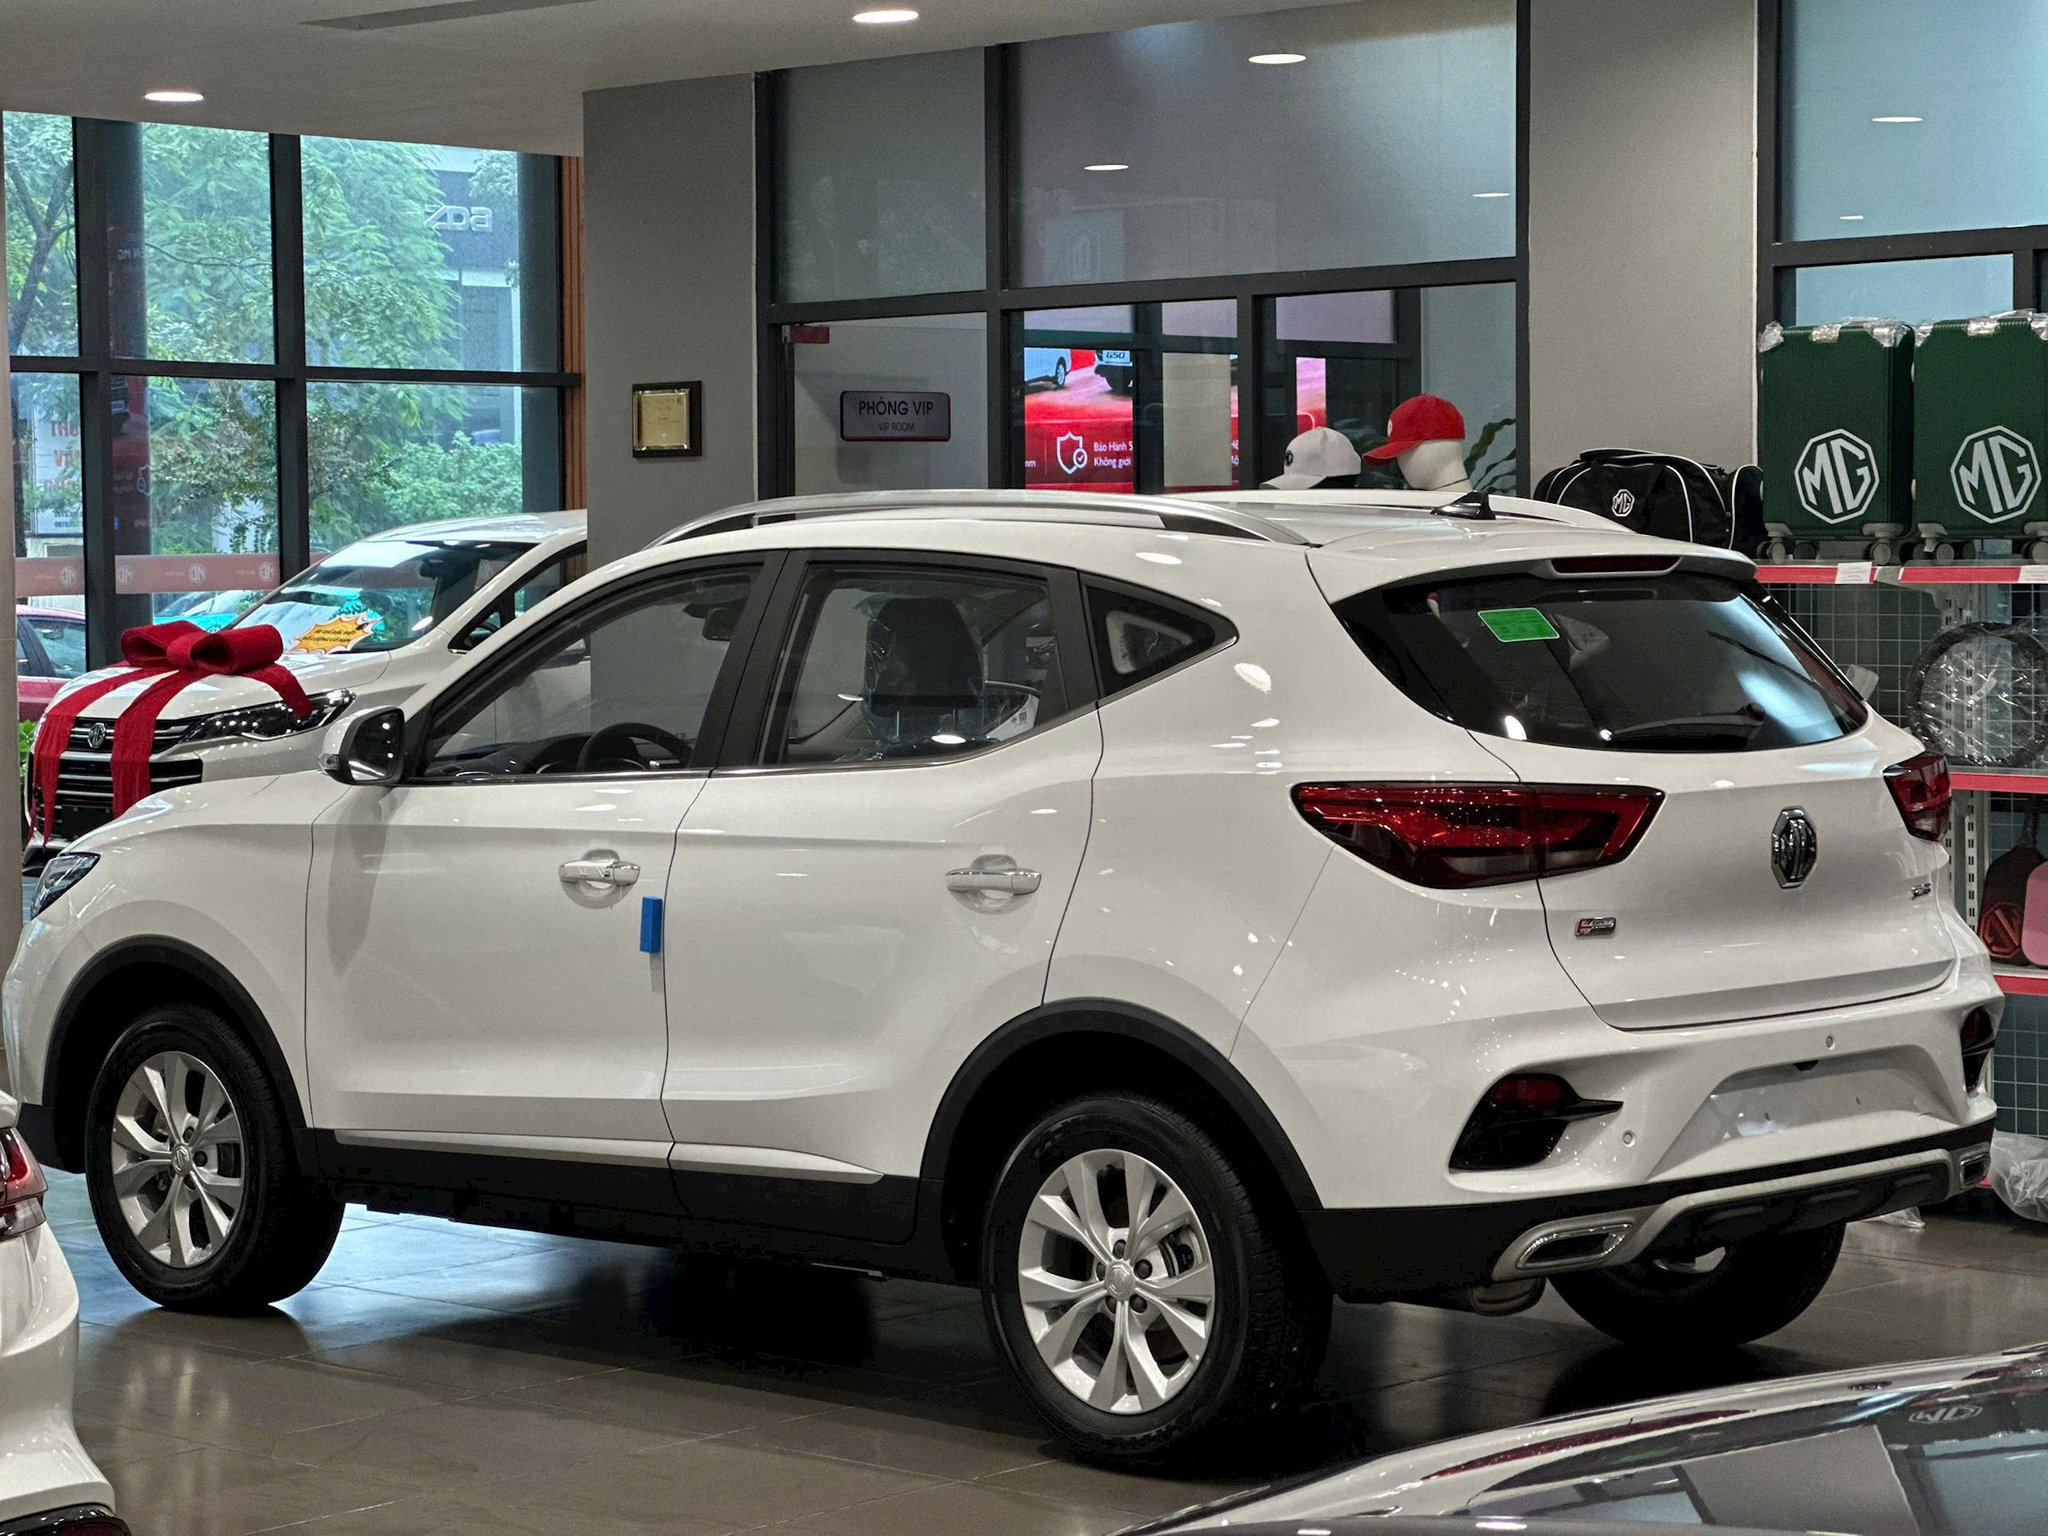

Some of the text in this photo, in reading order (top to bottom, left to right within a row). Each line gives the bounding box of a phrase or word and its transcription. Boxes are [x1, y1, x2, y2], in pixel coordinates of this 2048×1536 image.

[858, 396, 934, 416] PHÒNG VIP
[878, 422, 890, 432] VIP
[1094, 456, 1117, 469] Không
[1802, 437, 1872, 515] MG
[1959, 434, 2034, 514] MG
[1613, 491, 1633, 515] MG
